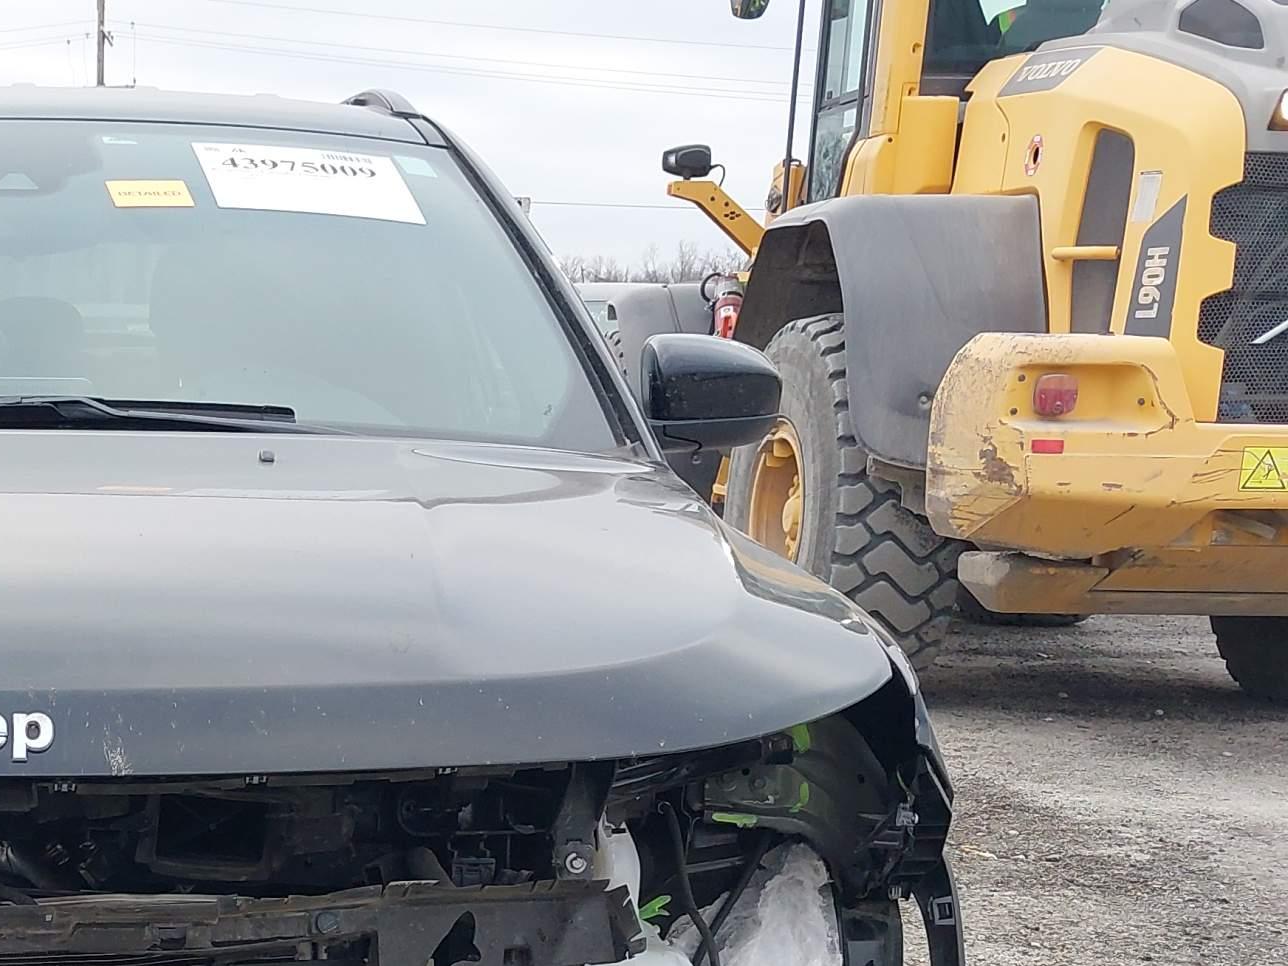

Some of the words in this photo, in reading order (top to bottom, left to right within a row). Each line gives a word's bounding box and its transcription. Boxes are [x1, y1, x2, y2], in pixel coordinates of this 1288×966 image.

[1017, 59, 1081, 82] VOLVO
[222, 156, 377, 178] 43975009
[1135, 246, 1170, 319] L90H
